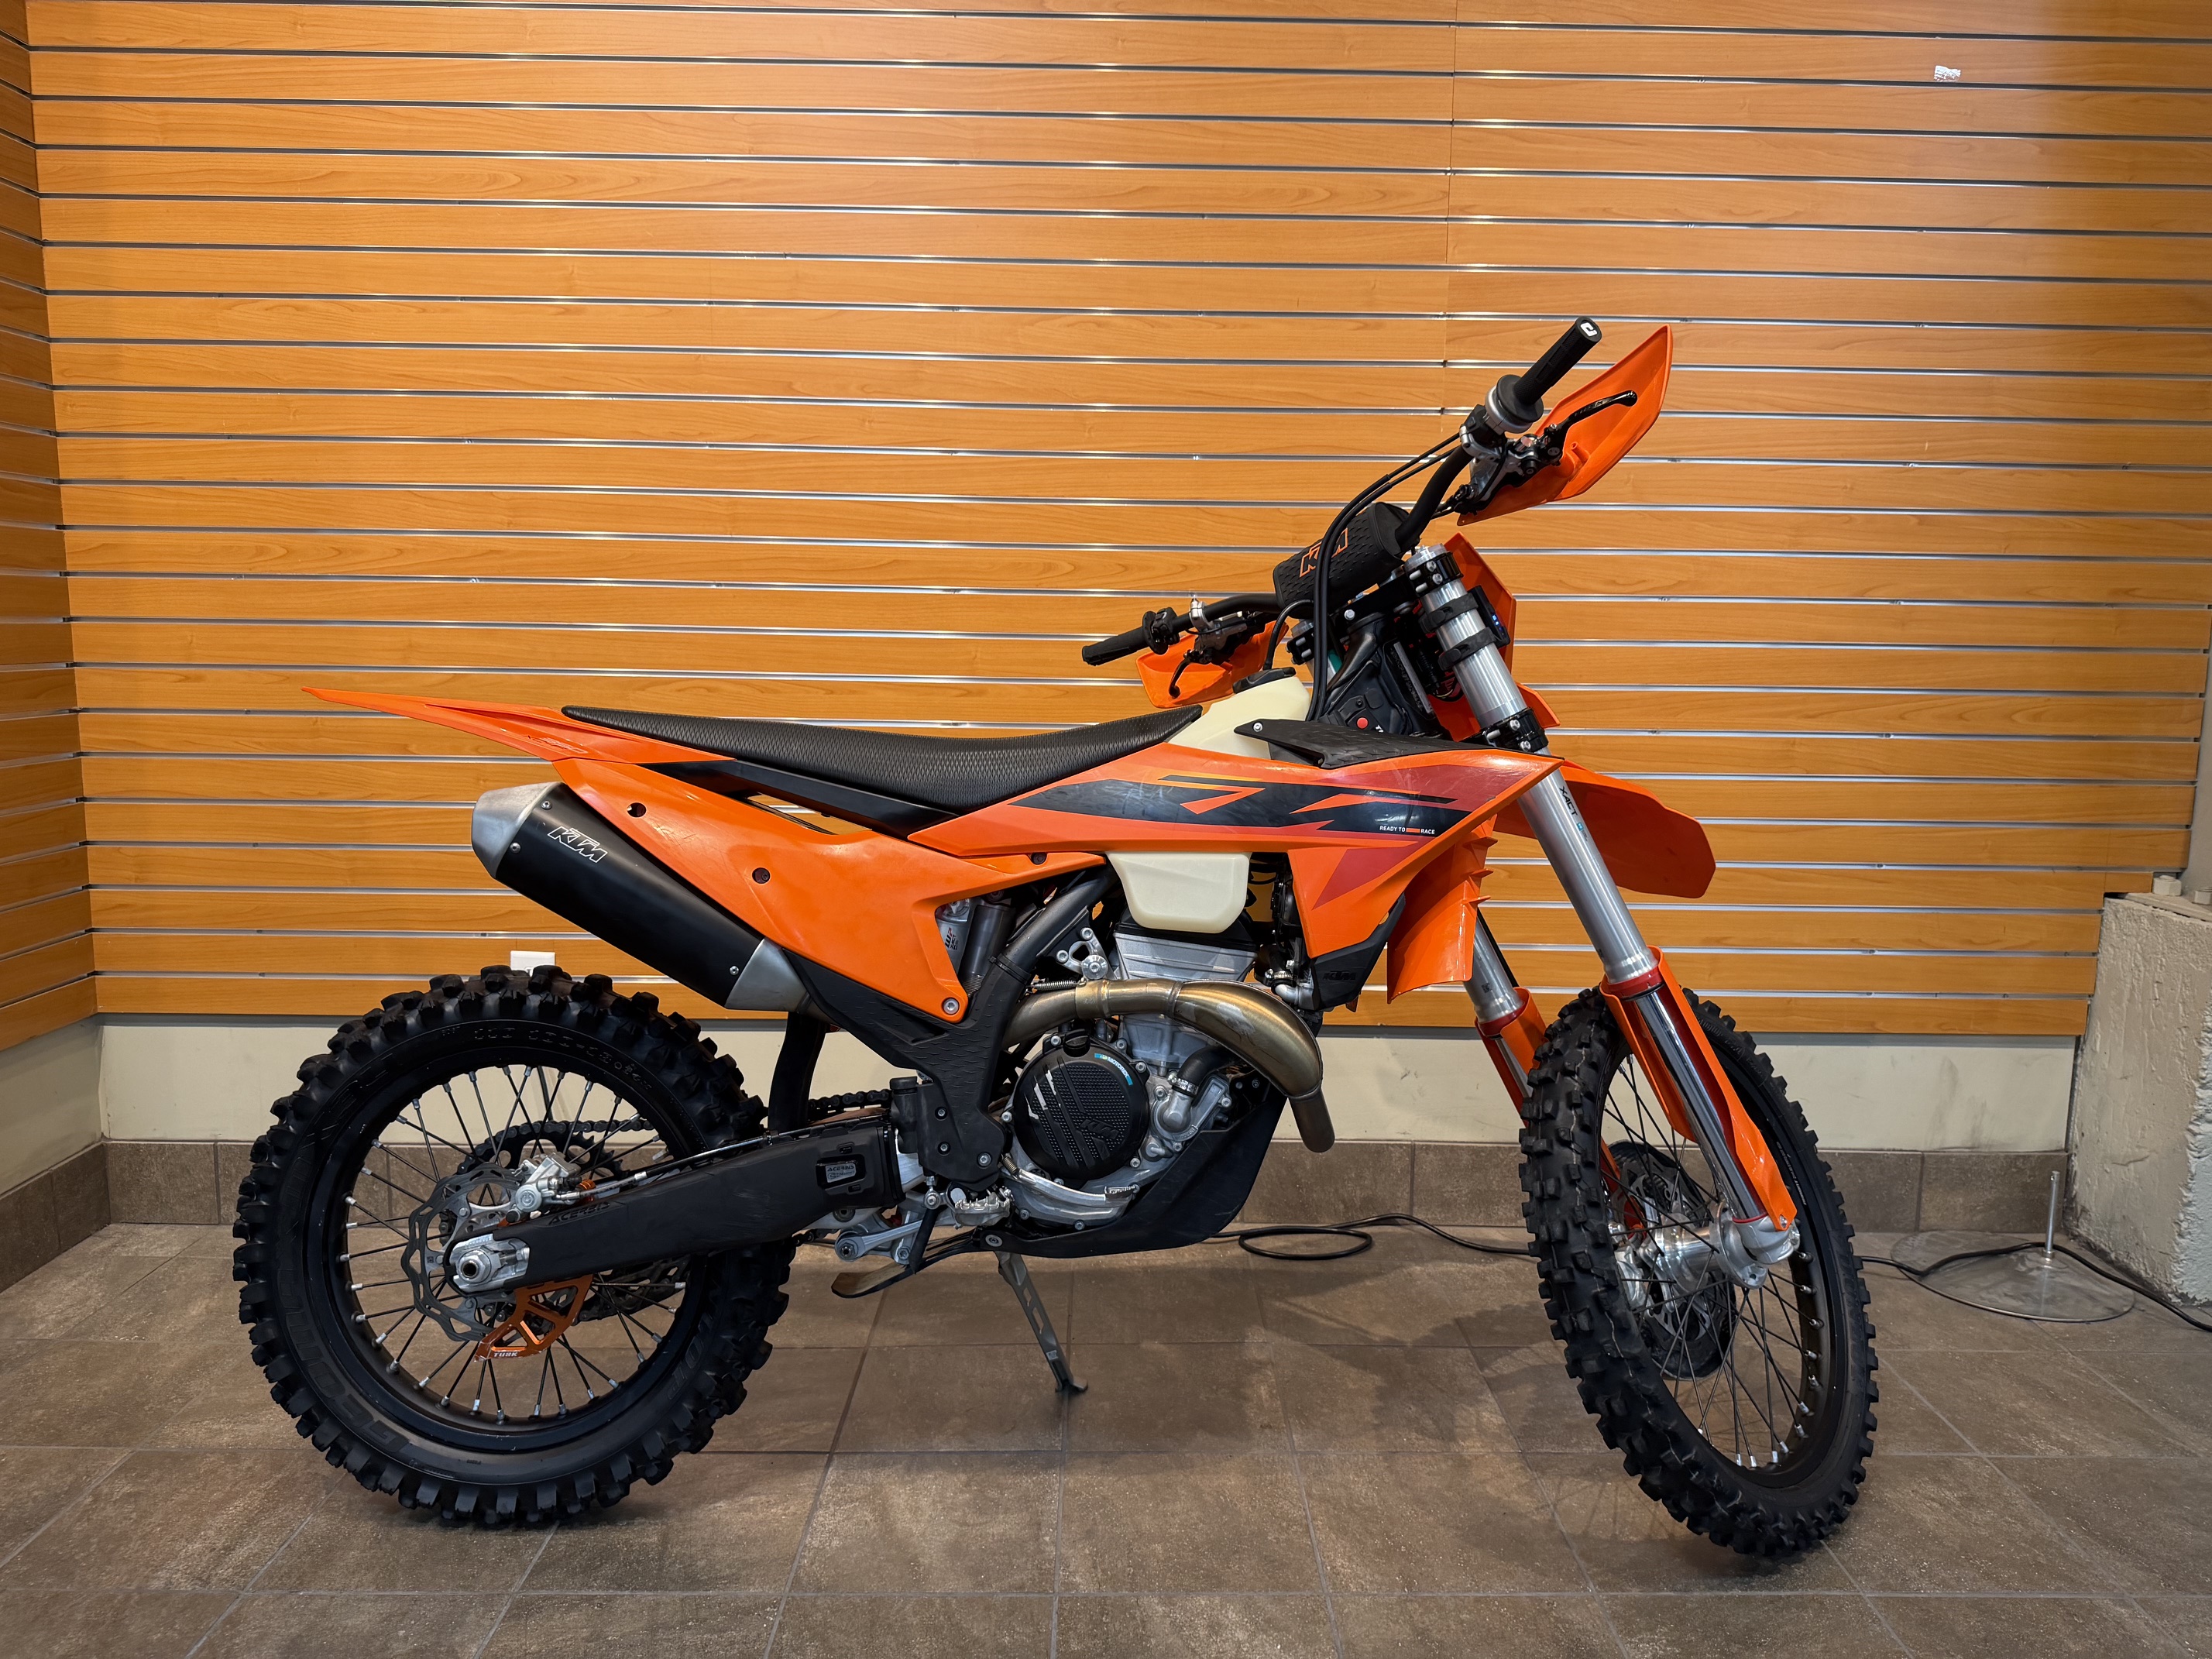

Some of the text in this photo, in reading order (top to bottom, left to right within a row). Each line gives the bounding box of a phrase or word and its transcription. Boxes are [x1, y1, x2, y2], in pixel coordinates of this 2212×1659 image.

[1559, 785, 1578, 816] XACT
[547, 826, 608, 864] KTM
[1323, 970, 1357, 981] KTM
[1108, 1056, 1130, 1078] MOTOREX
[1080, 1118, 1120, 1140] KTM
[548, 1201, 610, 1225] ACERBIS
